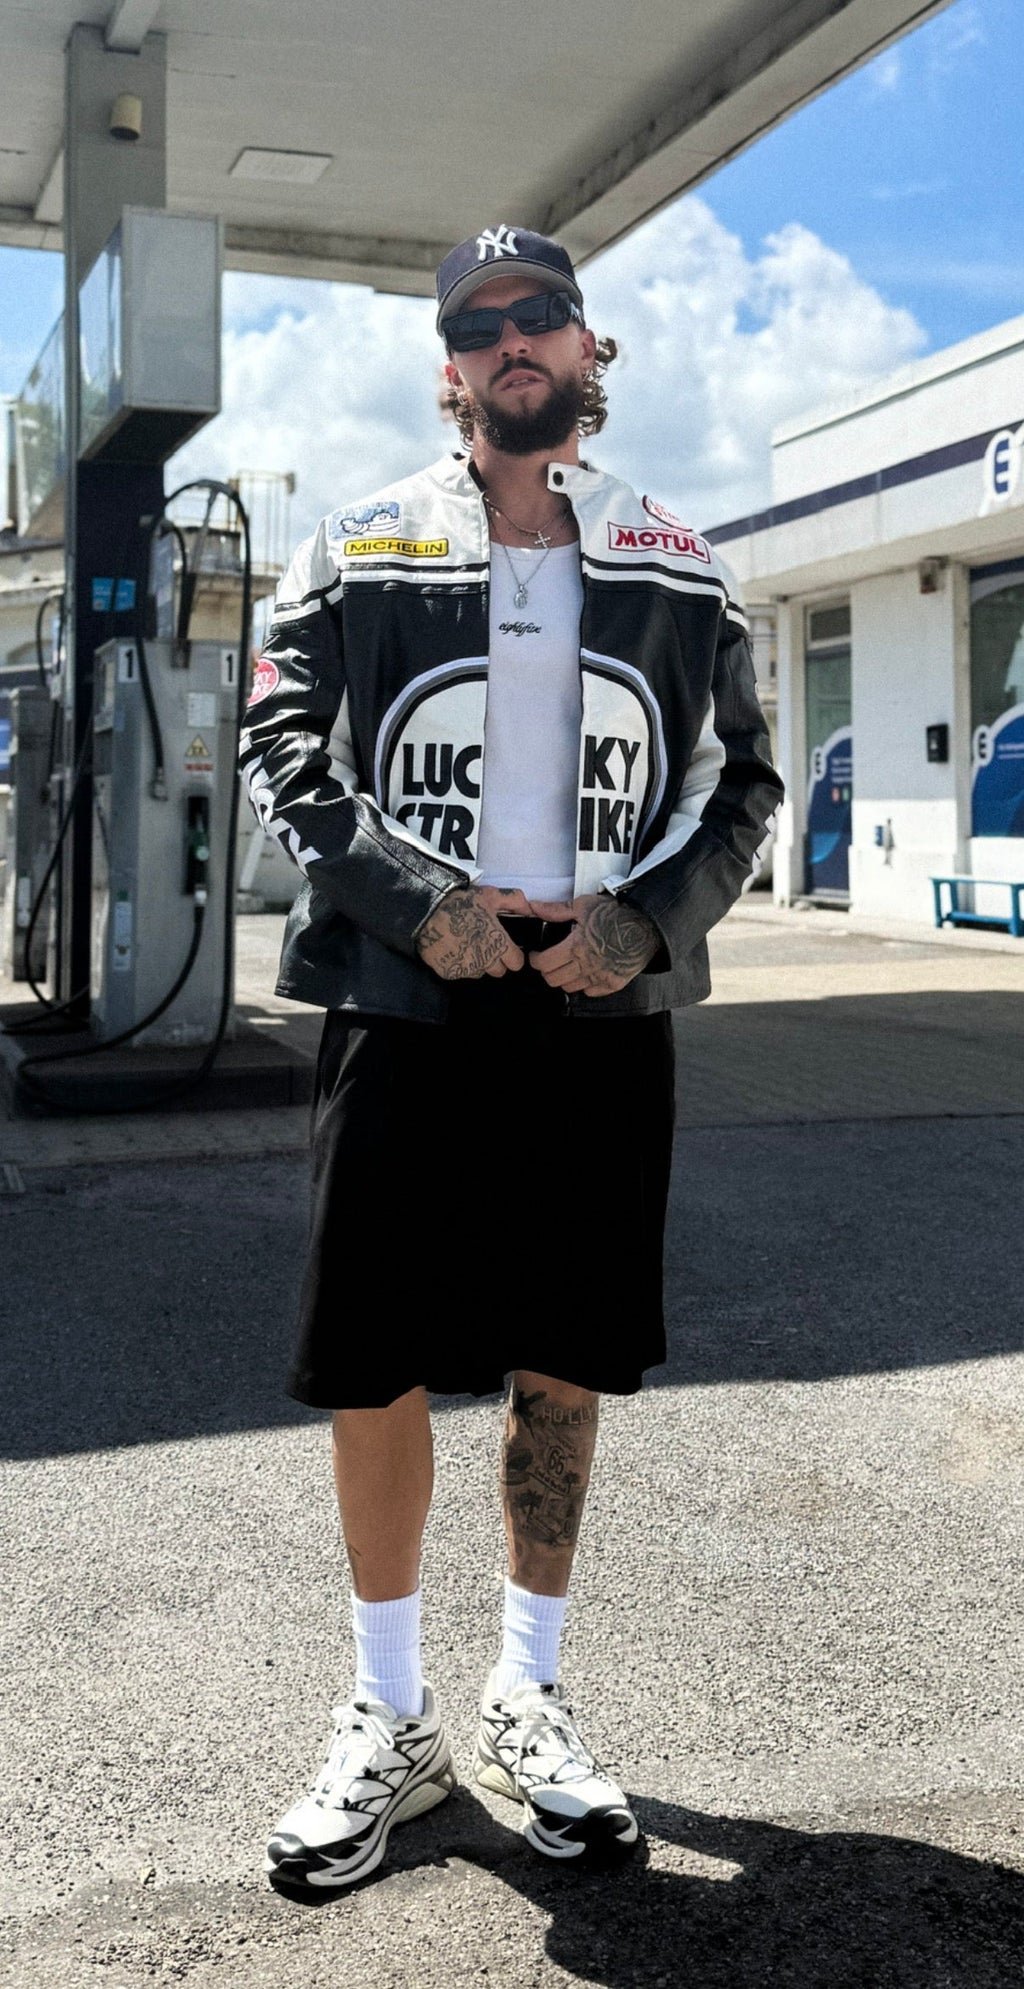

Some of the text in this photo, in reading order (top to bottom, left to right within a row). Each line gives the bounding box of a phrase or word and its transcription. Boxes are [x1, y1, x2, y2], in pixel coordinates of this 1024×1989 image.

[476, 224, 518, 261] NY
[349, 541, 443, 554] MICHELIN
[615, 528, 705, 557] MOTUL
[499, 621, 542, 637] eightyfive
[125, 649, 134, 679] 1
[226, 653, 233, 682] 1
[402, 734, 641, 798] LUC KY
[579, 796, 635, 855] IKE
[542, 1404, 598, 1425] HOLLY
